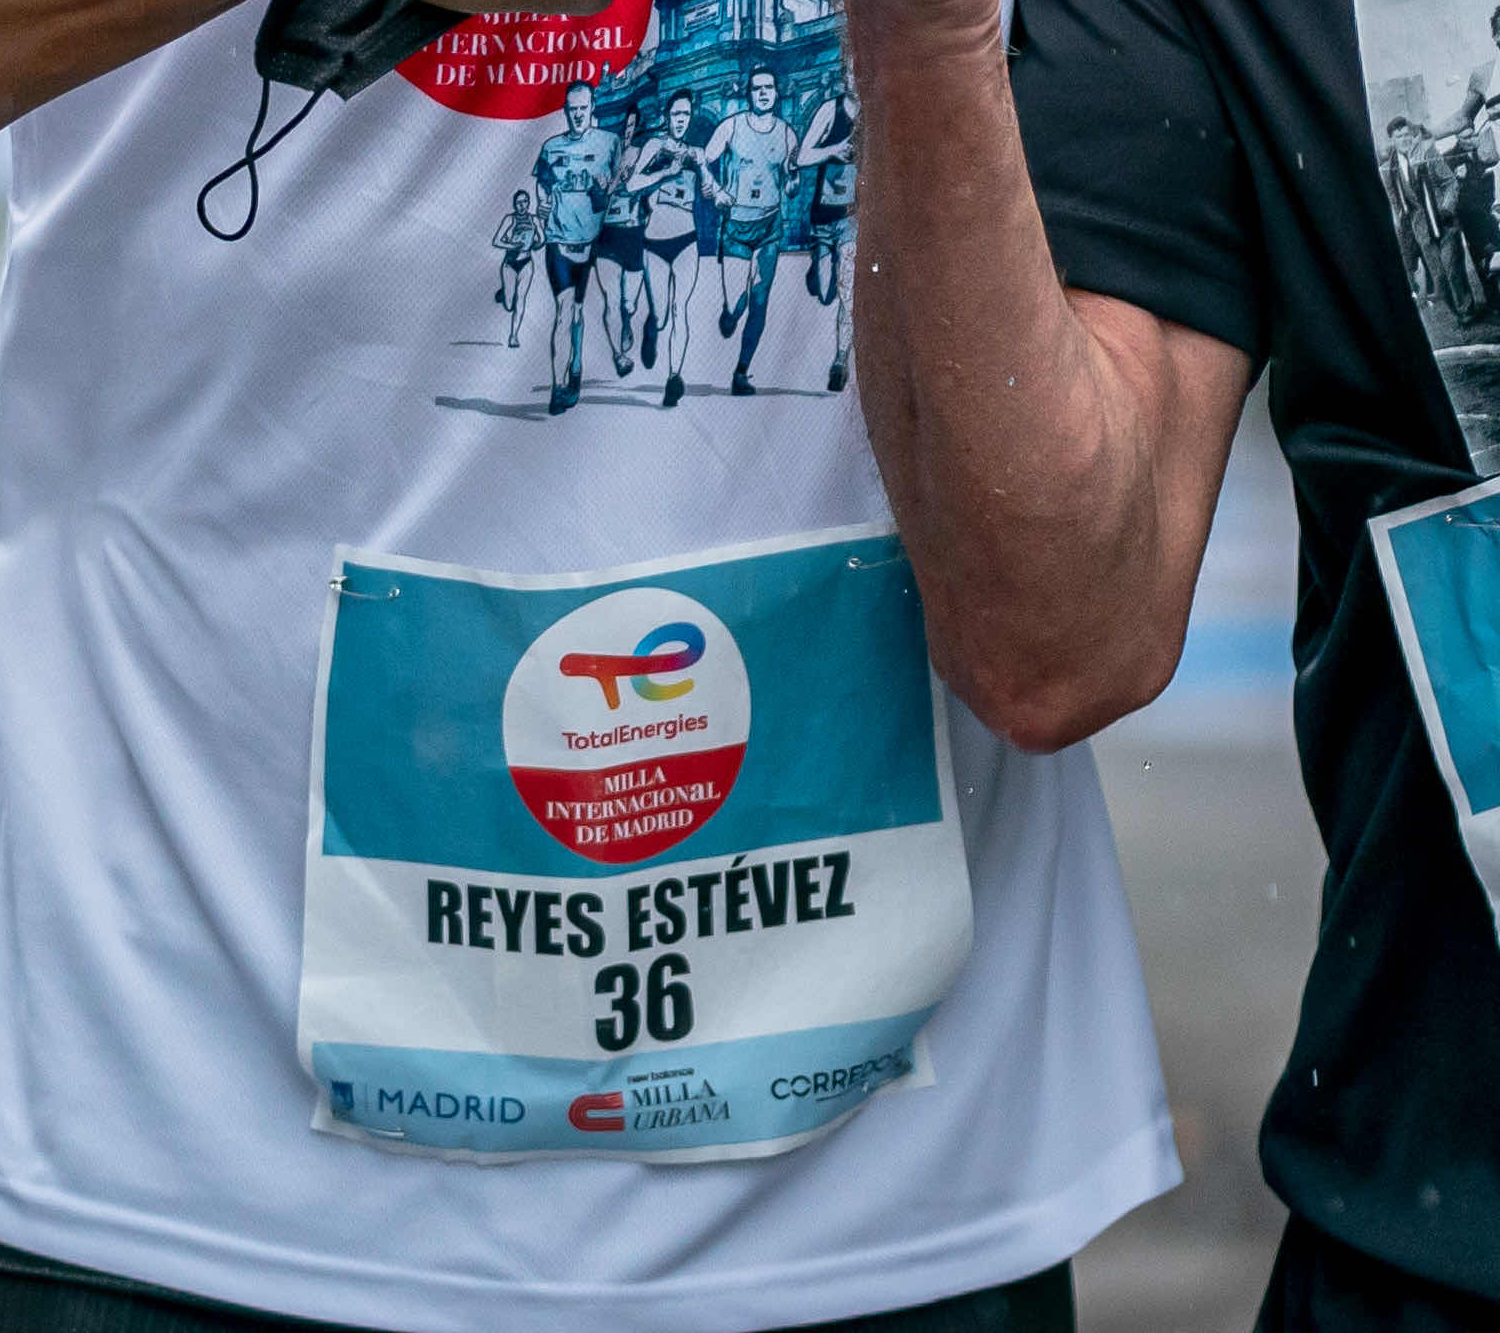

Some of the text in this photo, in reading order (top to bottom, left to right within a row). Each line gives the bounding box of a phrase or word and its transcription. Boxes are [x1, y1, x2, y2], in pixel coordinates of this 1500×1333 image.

[435, 60, 596, 87] DE MADRID
[562, 714, 709, 750] TotalEnergies
[603, 766, 666, 795] MILLA
[577, 809, 694, 845] DE MADRID
[427, 850, 856, 958] REYES ESTÉVEZ
[594, 952, 694, 1052] 36
[377, 1088, 526, 1124] MADRID
[631, 1078, 716, 1106] MILLA
[633, 1100, 730, 1130] URBANA
